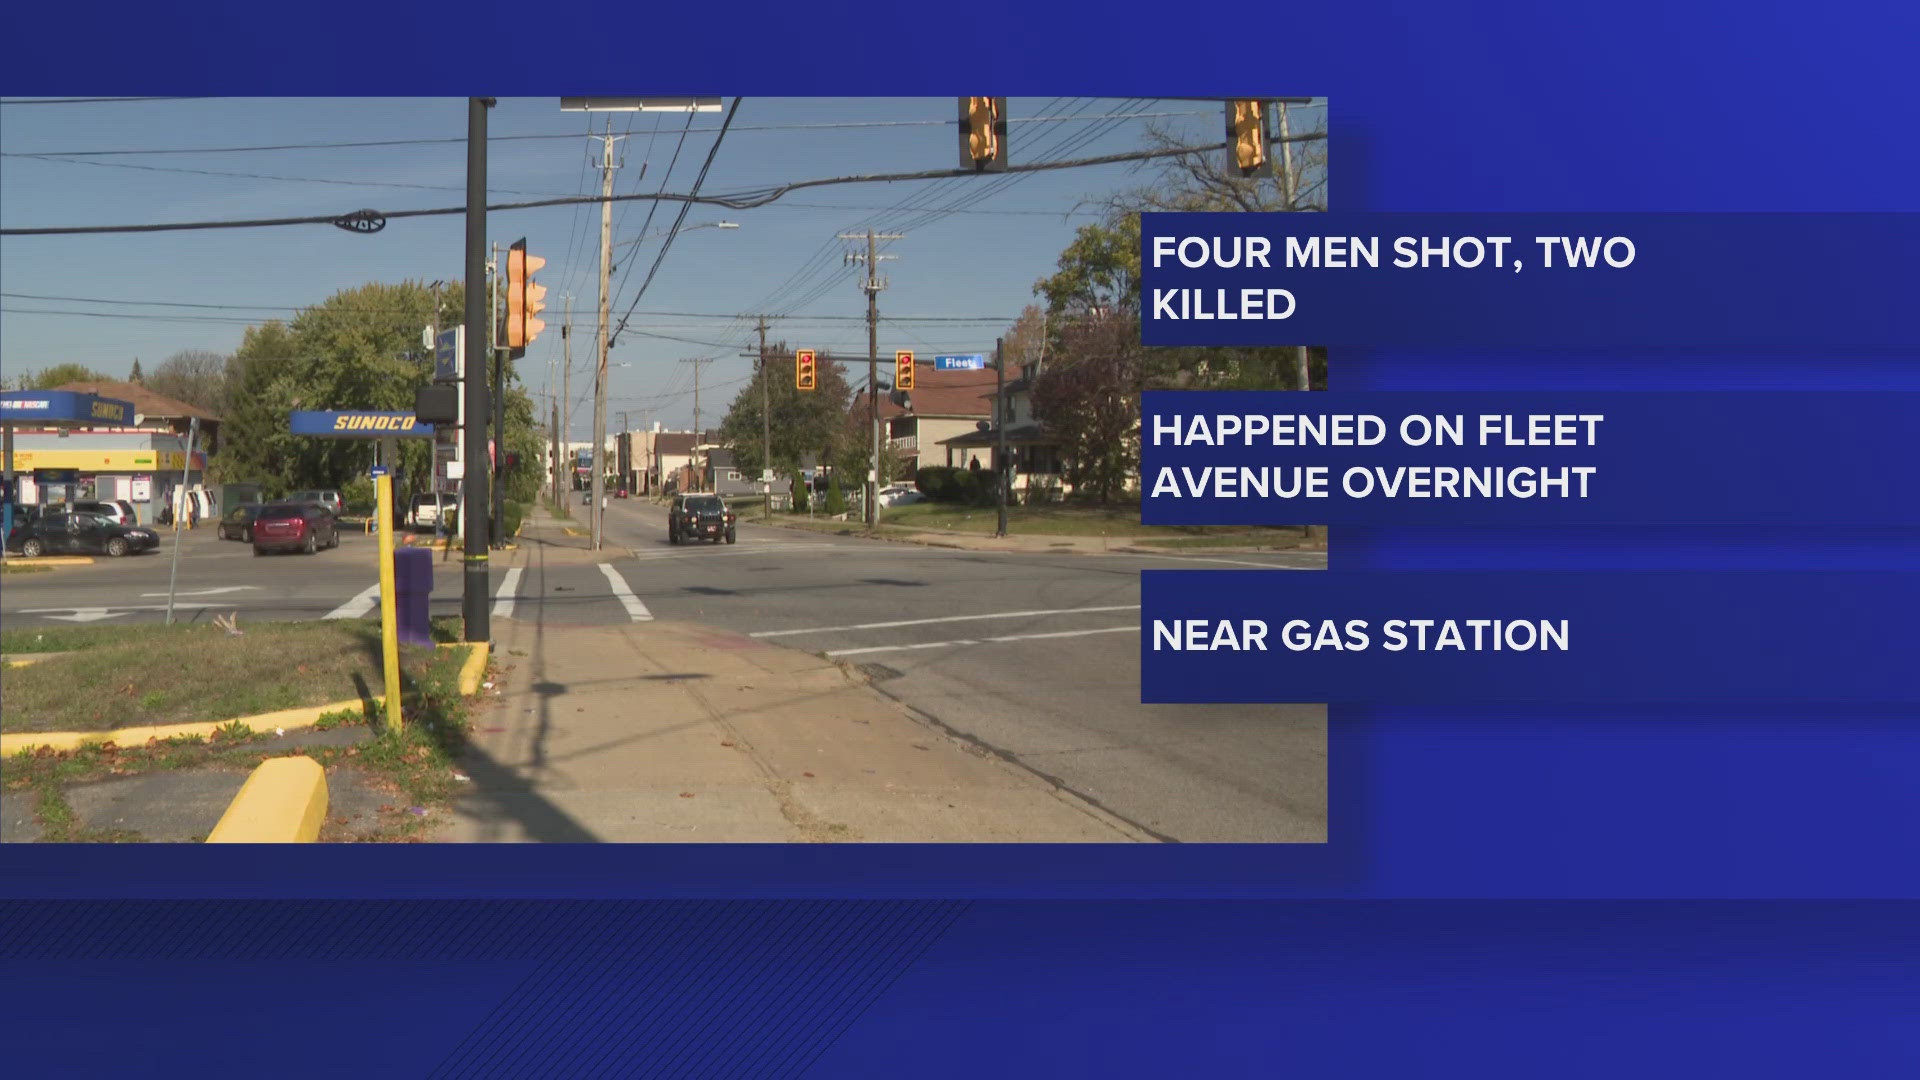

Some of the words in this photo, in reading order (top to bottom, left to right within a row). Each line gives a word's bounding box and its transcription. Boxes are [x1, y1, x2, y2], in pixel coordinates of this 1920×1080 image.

[945, 357, 973, 368] Fleet
[91, 401, 124, 420] SUNOCO
[333, 415, 416, 431] SUNOCO
